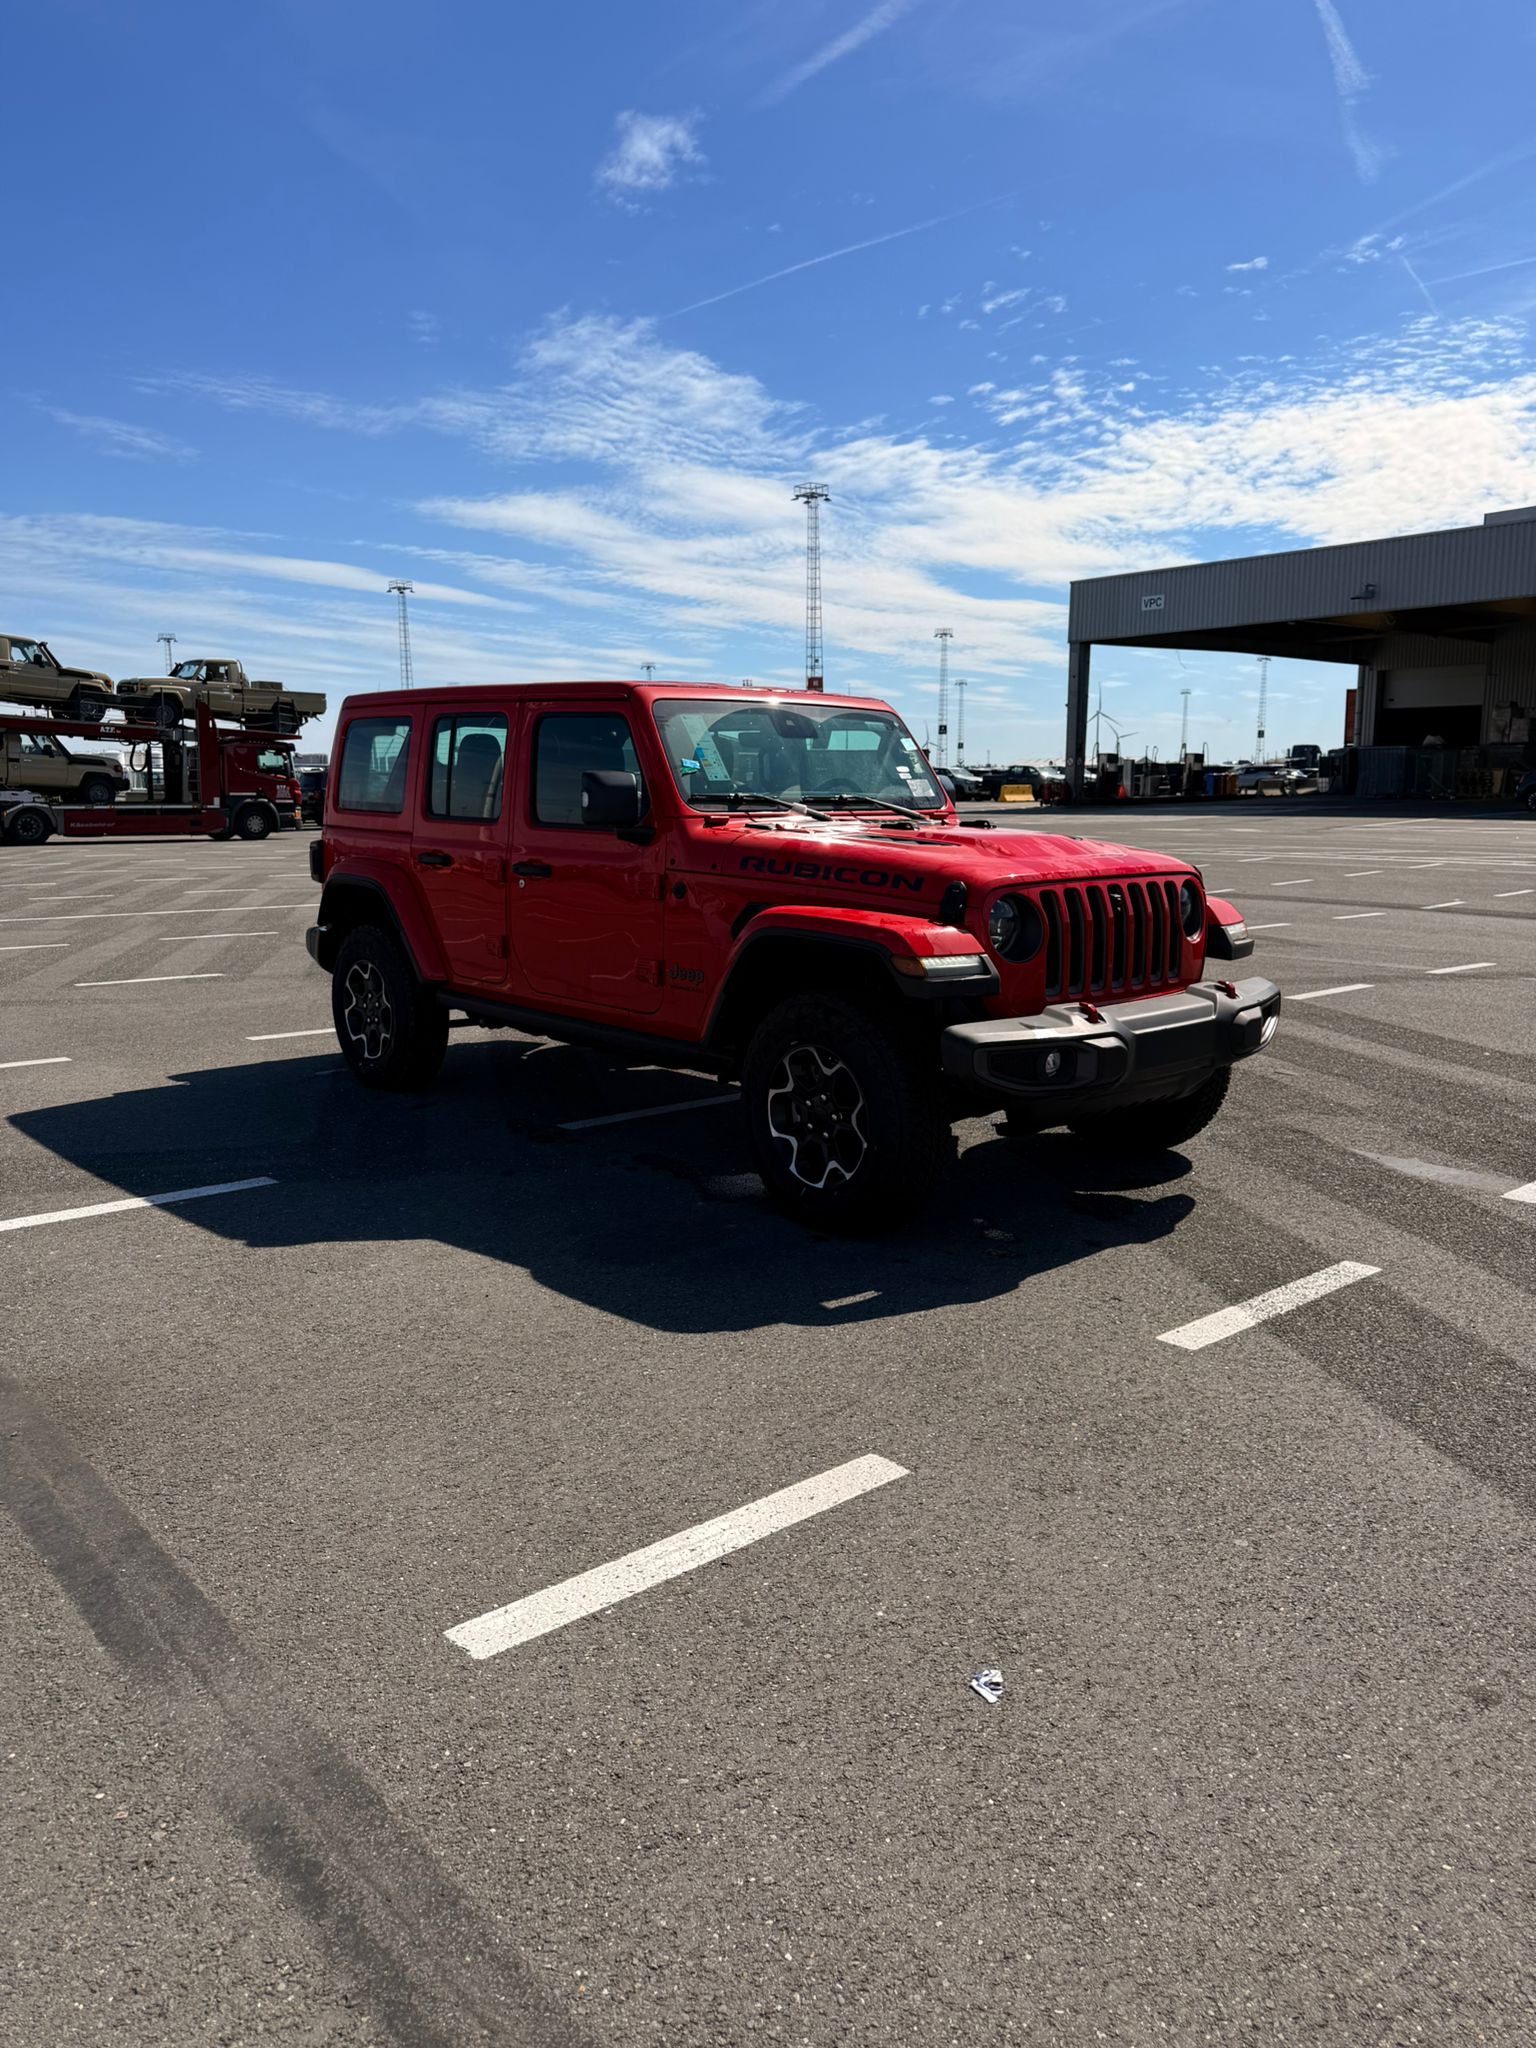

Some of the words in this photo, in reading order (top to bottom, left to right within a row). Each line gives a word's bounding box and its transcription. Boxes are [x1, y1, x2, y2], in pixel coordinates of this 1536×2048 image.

[1143, 597, 1162, 608] VPC
[739, 856, 924, 892] RUBICON
[669, 962, 704, 985] Jeep
